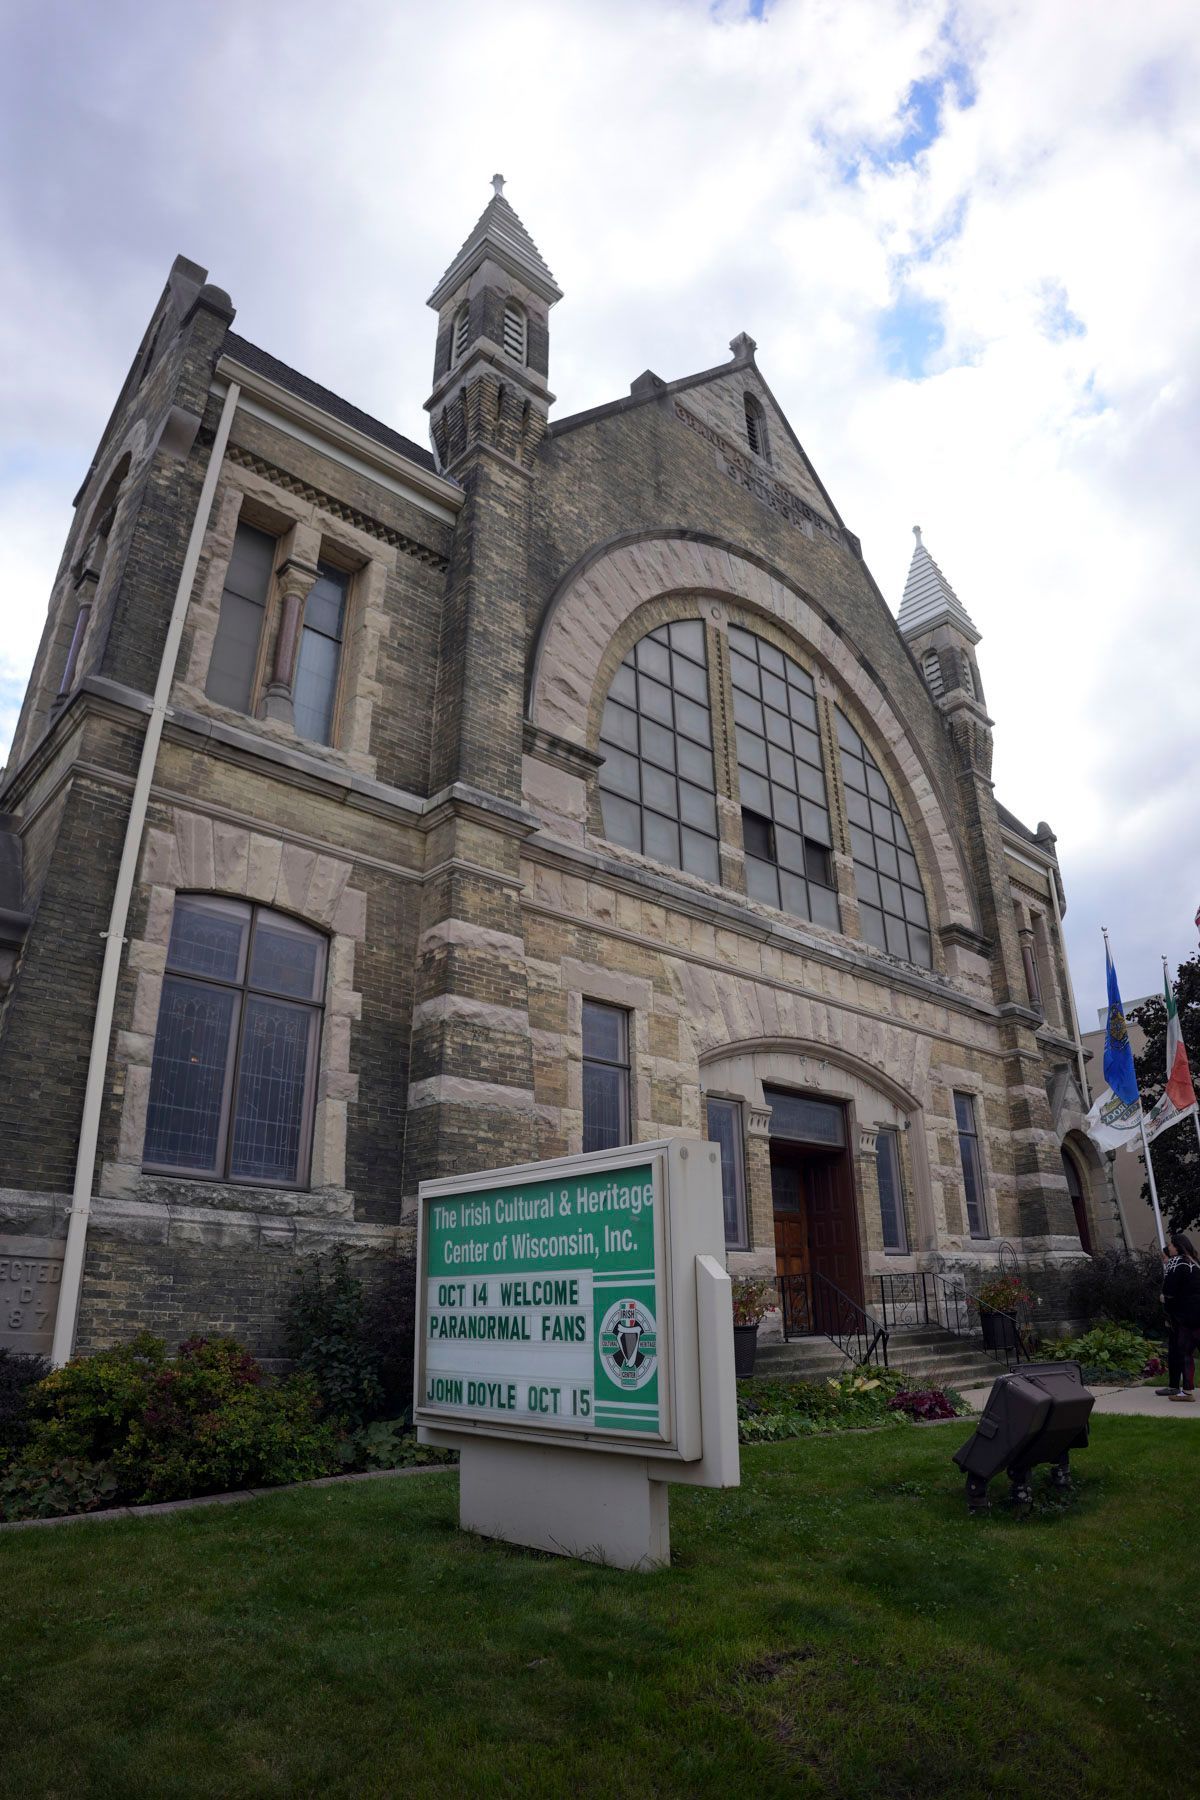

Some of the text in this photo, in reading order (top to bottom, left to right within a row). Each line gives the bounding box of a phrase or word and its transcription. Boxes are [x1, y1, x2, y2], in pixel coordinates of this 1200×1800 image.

[676, 406, 728, 454] GRAND
[727, 464, 804, 531] CHURCH
[433, 1183, 654, 1230] The Irish Cultural & Heritage
[444, 1224, 638, 1264] Center of Wisconsin, Inc.
[438, 1279, 578, 1307] OCT 14 WELCOME
[430, 1315, 586, 1342] PARANORMAL FANS
[620, 1309, 635, 1319] IRISH
[427, 1378, 591, 1416] JOHN DOYLE OCT 15
